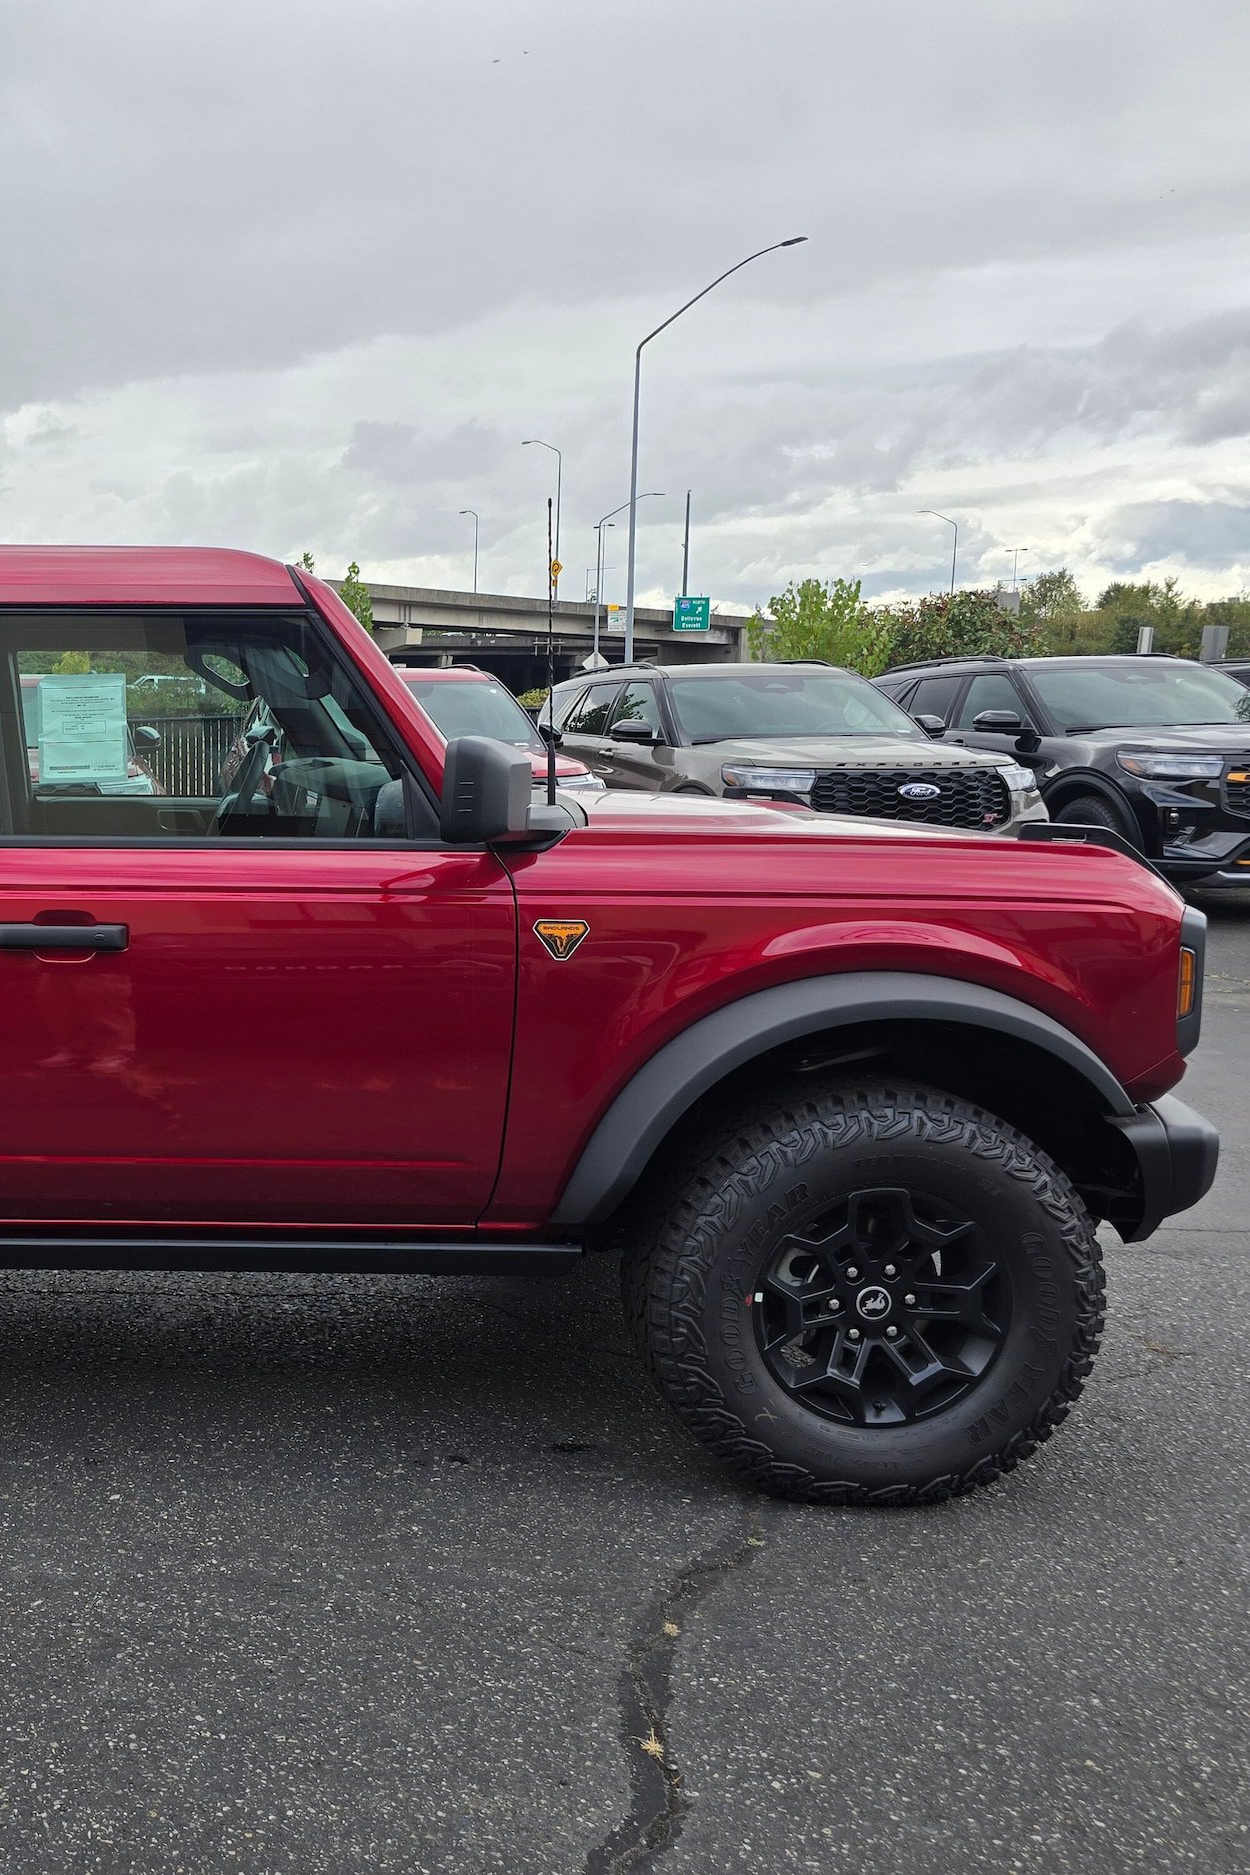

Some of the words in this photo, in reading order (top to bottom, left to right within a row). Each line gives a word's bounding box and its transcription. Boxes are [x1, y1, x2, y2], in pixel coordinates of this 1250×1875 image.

[982, 813, 998, 823] ST
[719, 1181, 813, 1396] GOODYEAR
[964, 1231, 1062, 1445] GOODYEAR
